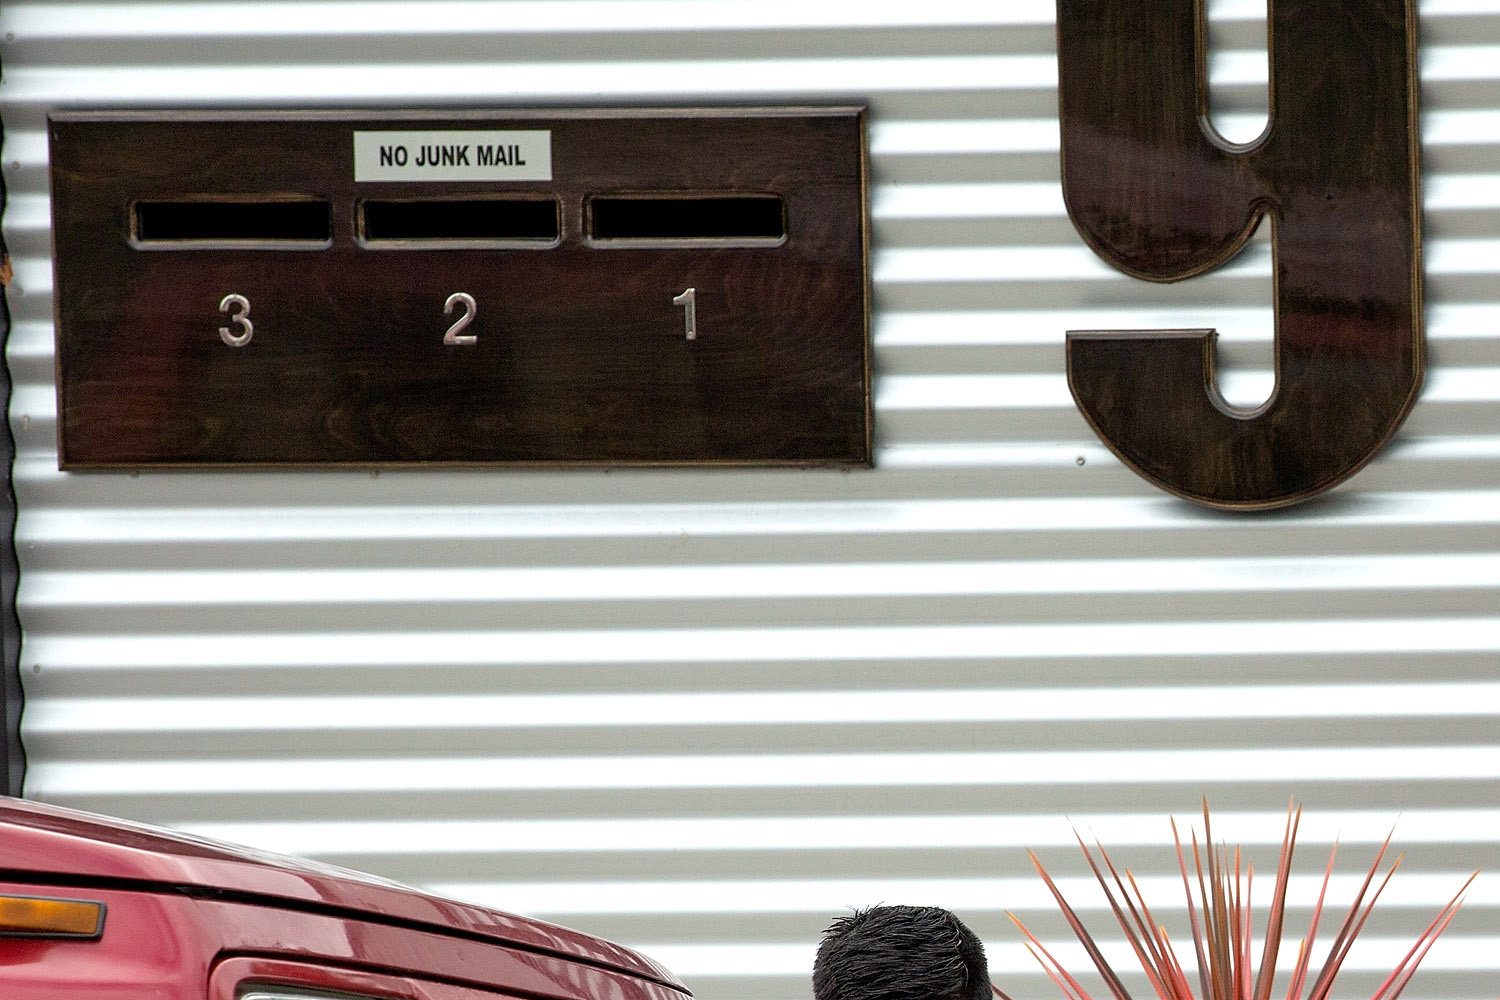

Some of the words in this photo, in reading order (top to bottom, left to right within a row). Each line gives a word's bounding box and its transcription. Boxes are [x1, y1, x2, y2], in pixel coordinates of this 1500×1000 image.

[379, 145, 408, 167] NO
[415, 144, 470, 167] JUNK
[477, 144, 526, 166] MAIL
[219, 293, 254, 347] 3
[443, 292, 478, 346] 2
[673, 287, 696, 341] 1
